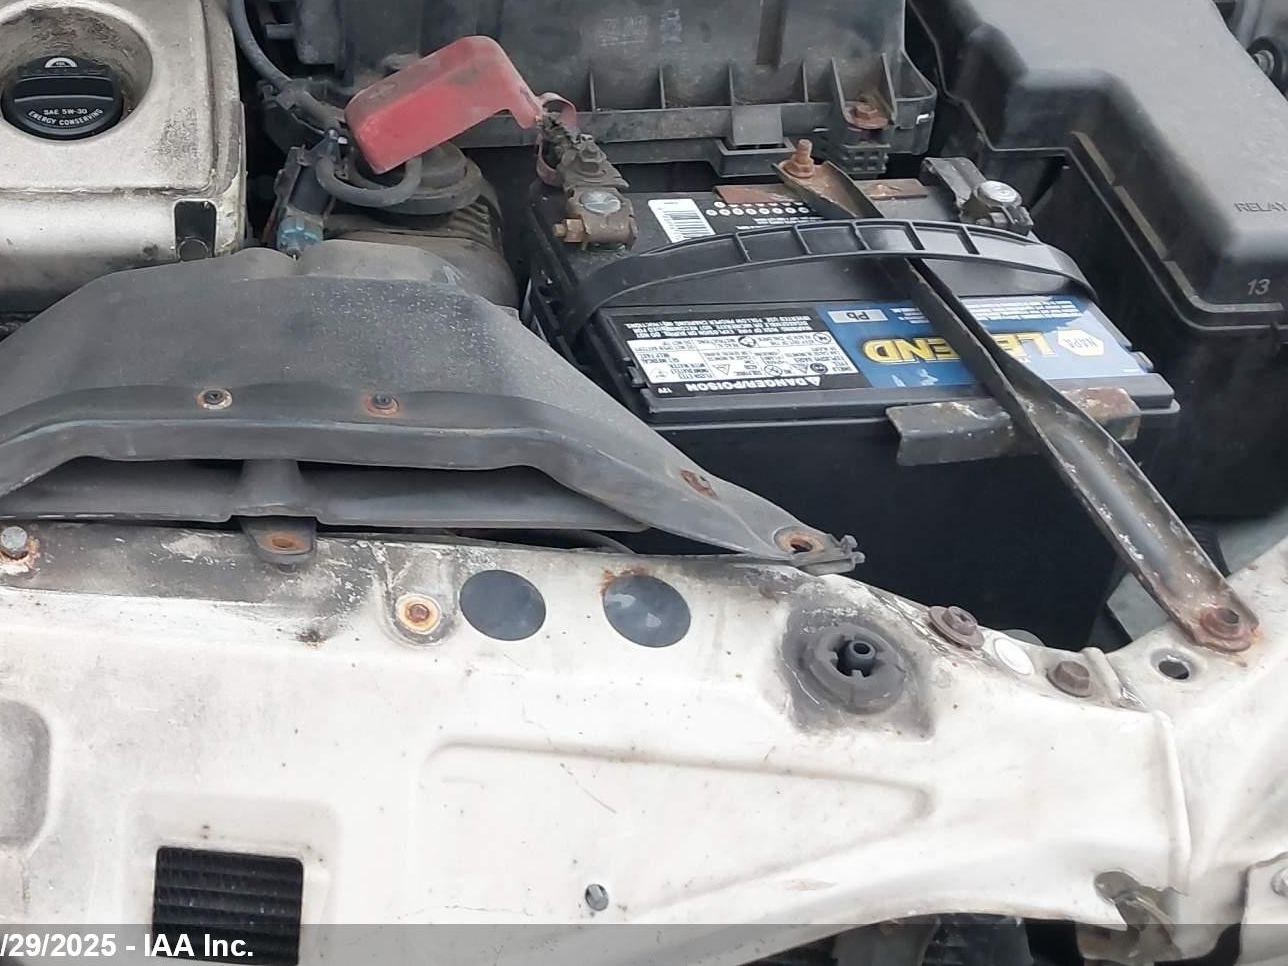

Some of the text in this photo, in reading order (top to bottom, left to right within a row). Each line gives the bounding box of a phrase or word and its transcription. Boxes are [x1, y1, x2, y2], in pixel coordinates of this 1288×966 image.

[28, 108, 103, 126] ENERGY CONSERVING
[1247, 278, 1271, 296] 13
[847, 311, 869, 320] Pb
[863, 333, 1058, 364] LEEND
[685, 378, 809, 392] DANGER/POISON
